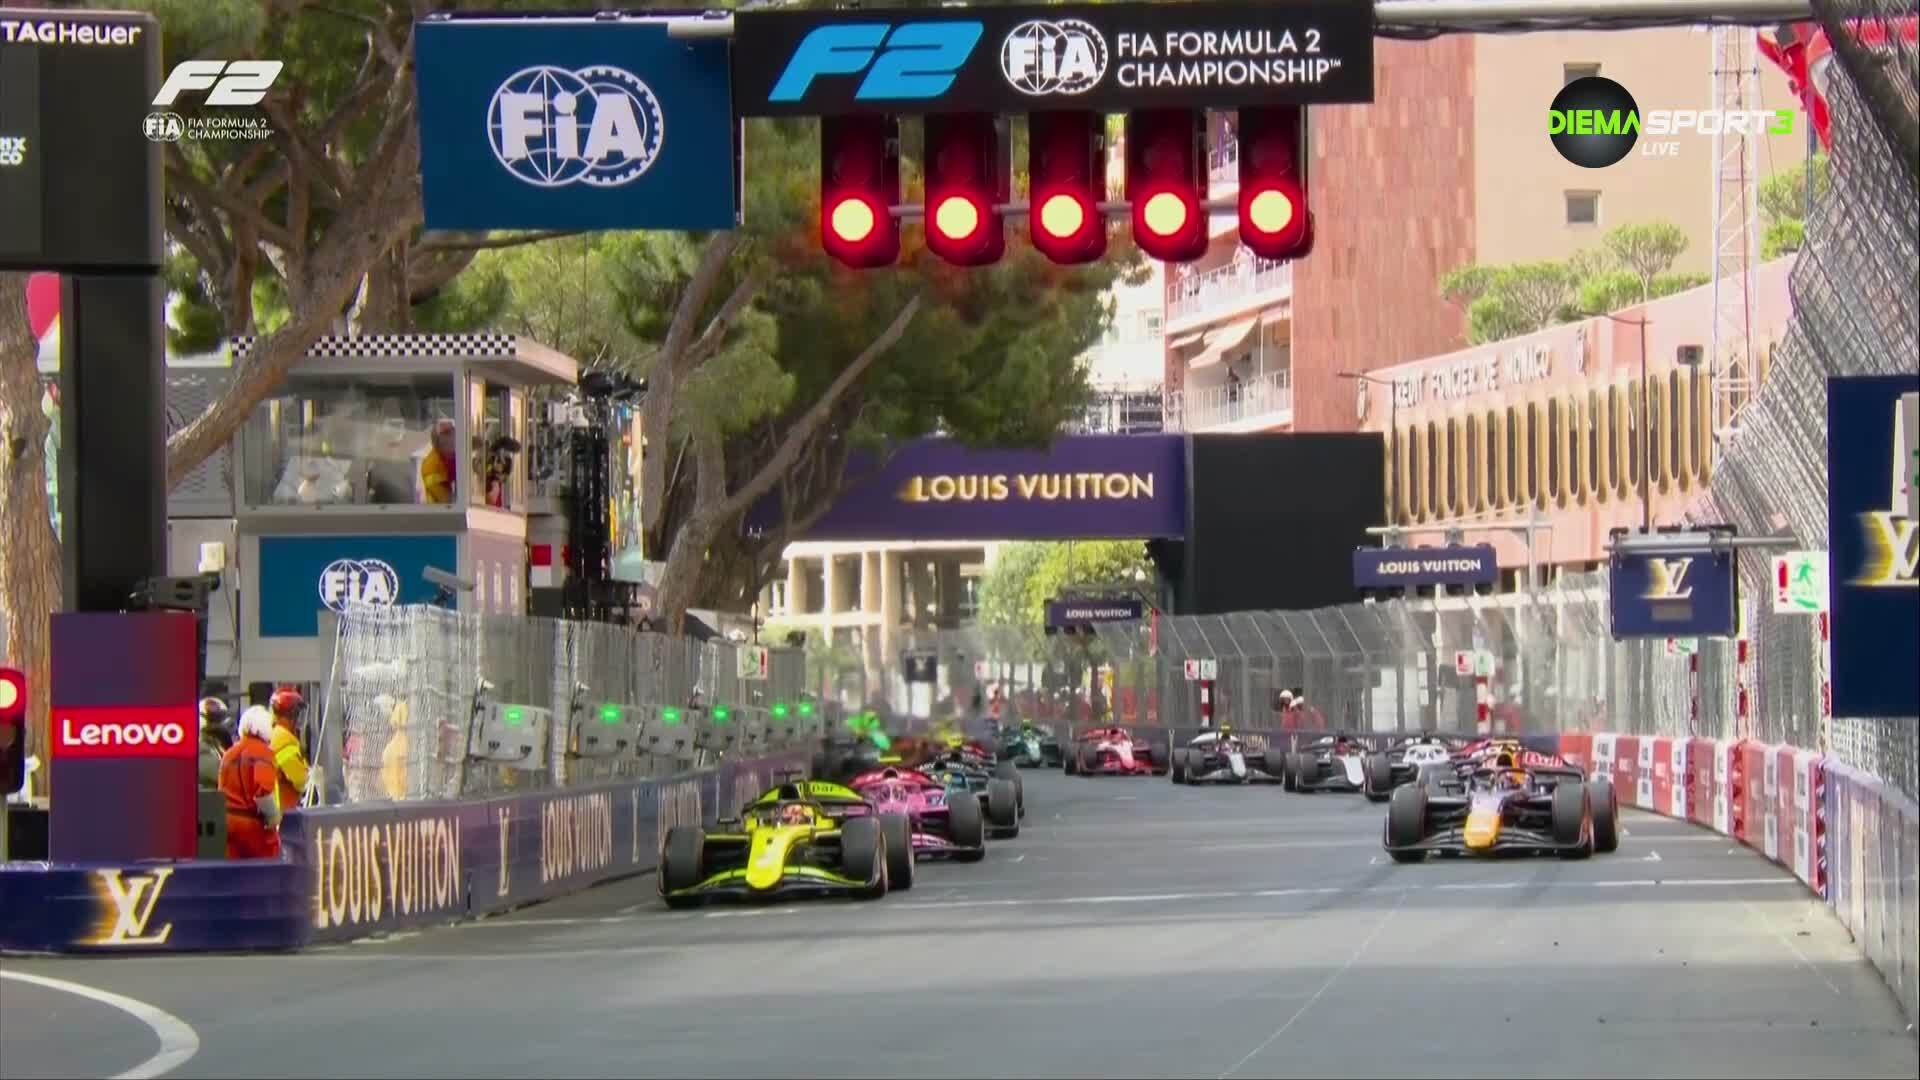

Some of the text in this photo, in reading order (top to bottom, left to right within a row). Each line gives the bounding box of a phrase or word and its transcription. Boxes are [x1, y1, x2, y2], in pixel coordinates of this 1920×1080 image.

[1117, 28, 1321, 57] FIA FORMULA 2
[767, 21, 985, 102] F2
[911, 472, 1155, 502] LOUIS VUITTON
[1377, 558, 1482, 575] LOUIS VUITTON
[61, 718, 185, 746] Lenovo
[540, 798, 573, 885] LOUIS
[313, 814, 462, 929] LOUIS VUITTON
